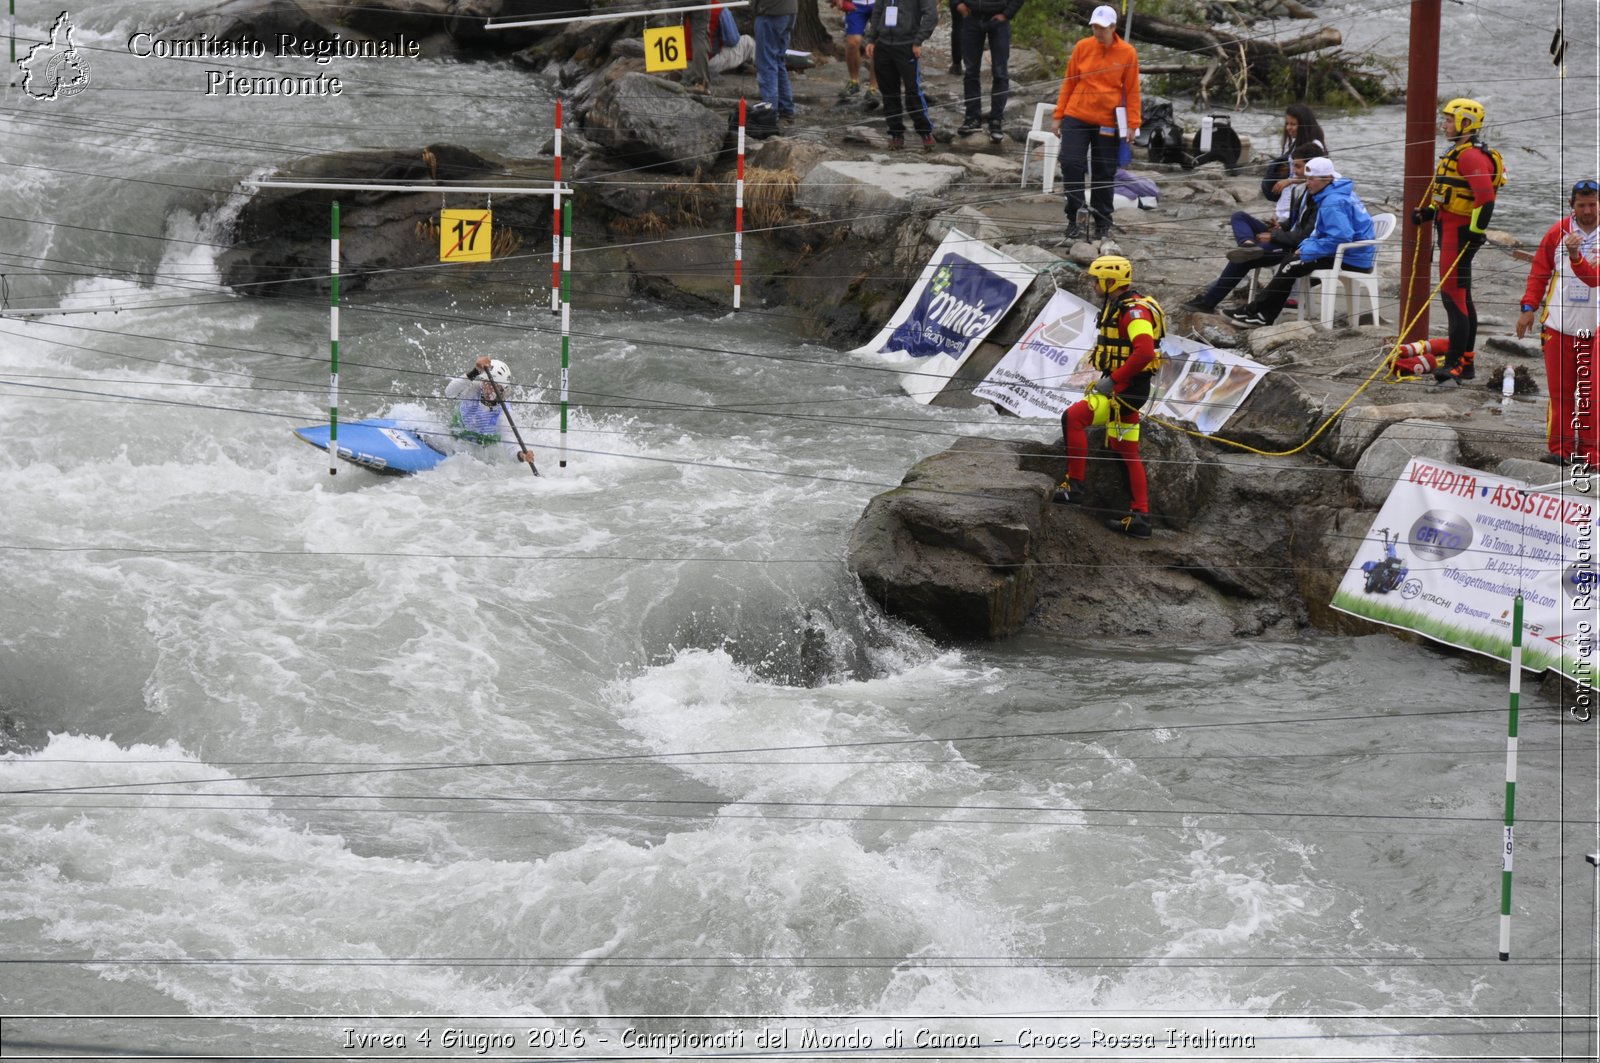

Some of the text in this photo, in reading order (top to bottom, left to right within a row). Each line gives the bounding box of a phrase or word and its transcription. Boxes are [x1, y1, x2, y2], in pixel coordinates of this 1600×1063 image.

[653, 35, 679, 63] 16
[452, 219, 482, 251] 17
[1408, 461, 1478, 501] VENDITA
[1480, 533, 1493, 548] Via
[1402, 582, 1421, 596] BCS
[1420, 592, 1452, 609] HITACHI
[1505, 826, 1513, 855] 19
